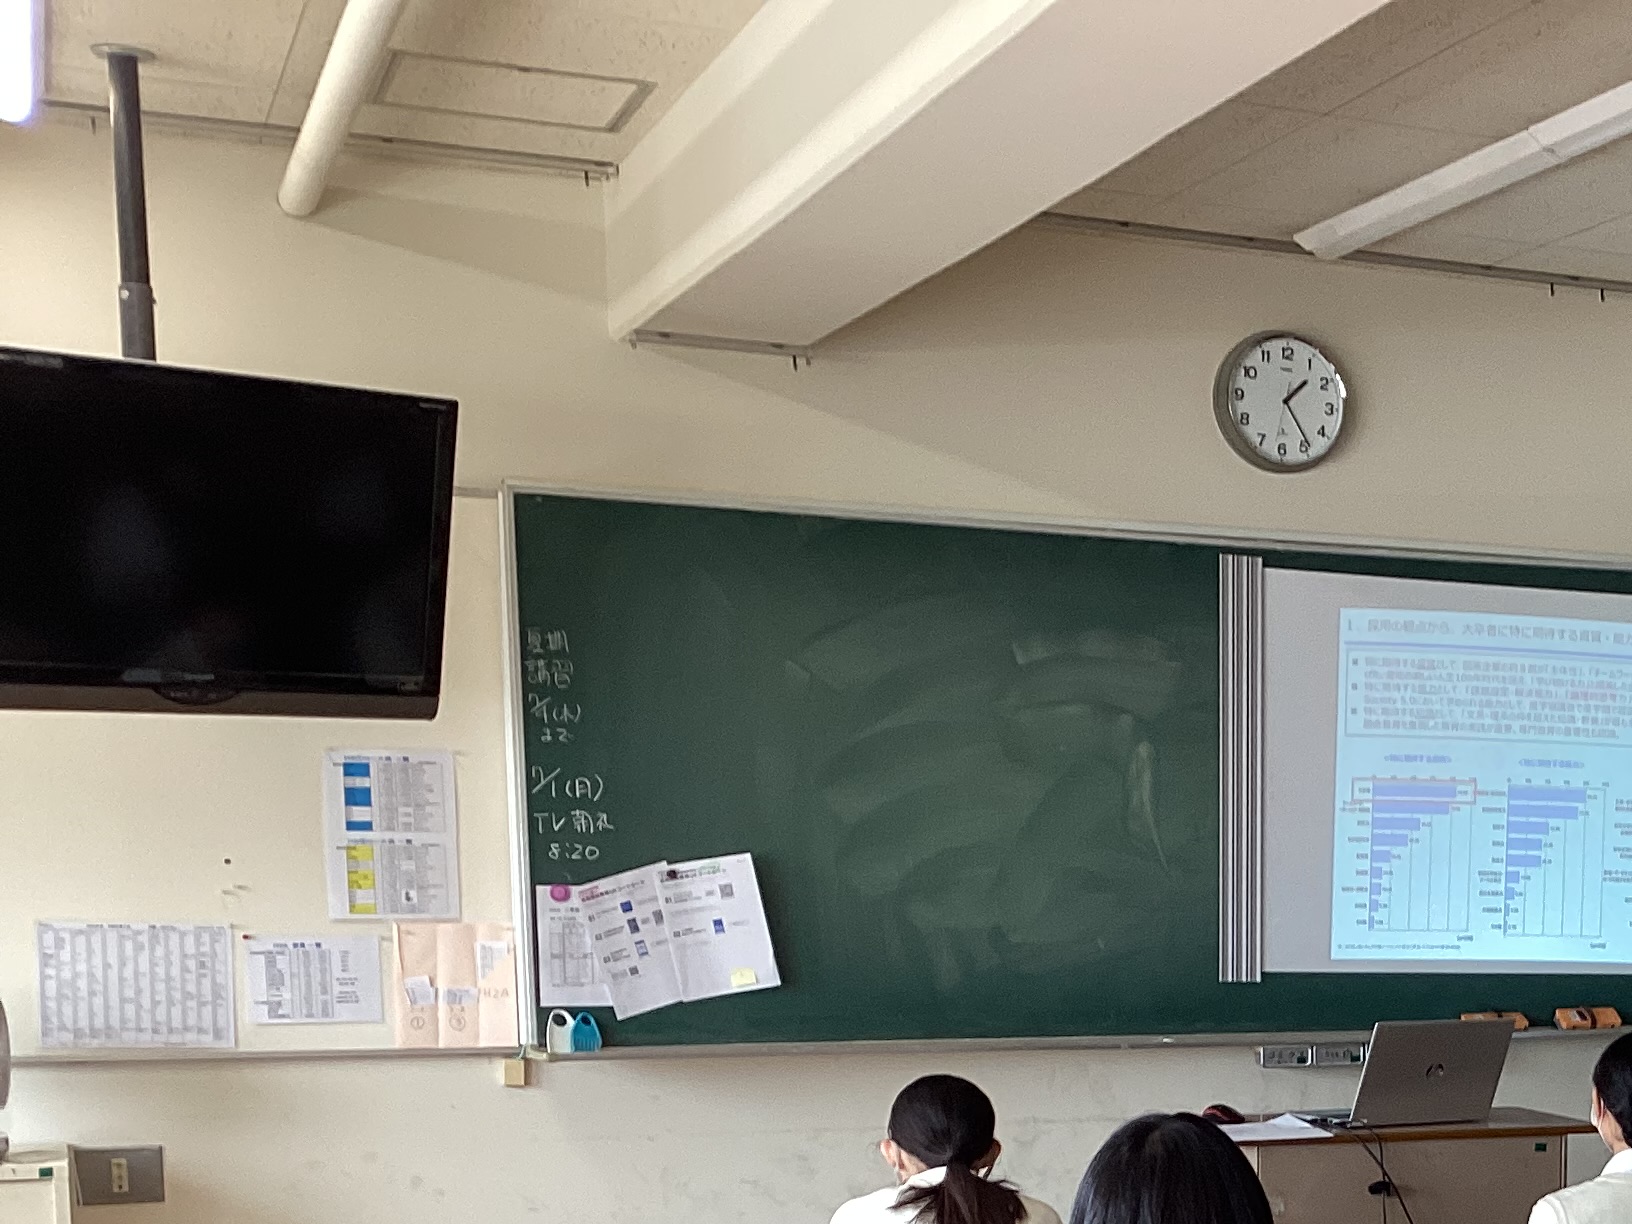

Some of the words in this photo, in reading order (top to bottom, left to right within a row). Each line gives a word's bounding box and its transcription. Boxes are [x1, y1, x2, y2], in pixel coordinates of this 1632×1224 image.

[1261, 349, 1271, 364] 11
[1281, 346, 1294, 361] 12
[1307, 356, 1312, 371] 1
[1243, 365, 1258, 380] 10
[1320, 376, 1329, 391] 2
[1234, 387, 1245, 401] 9
[1324, 402, 1334, 416] 3
[1240, 412, 1250, 426] 8
[1316, 424, 1326, 438] 4
[1256, 432, 1266, 447] 7
[1277, 442, 1287, 456] 6
[548, 842, 601, 861] 8:20
